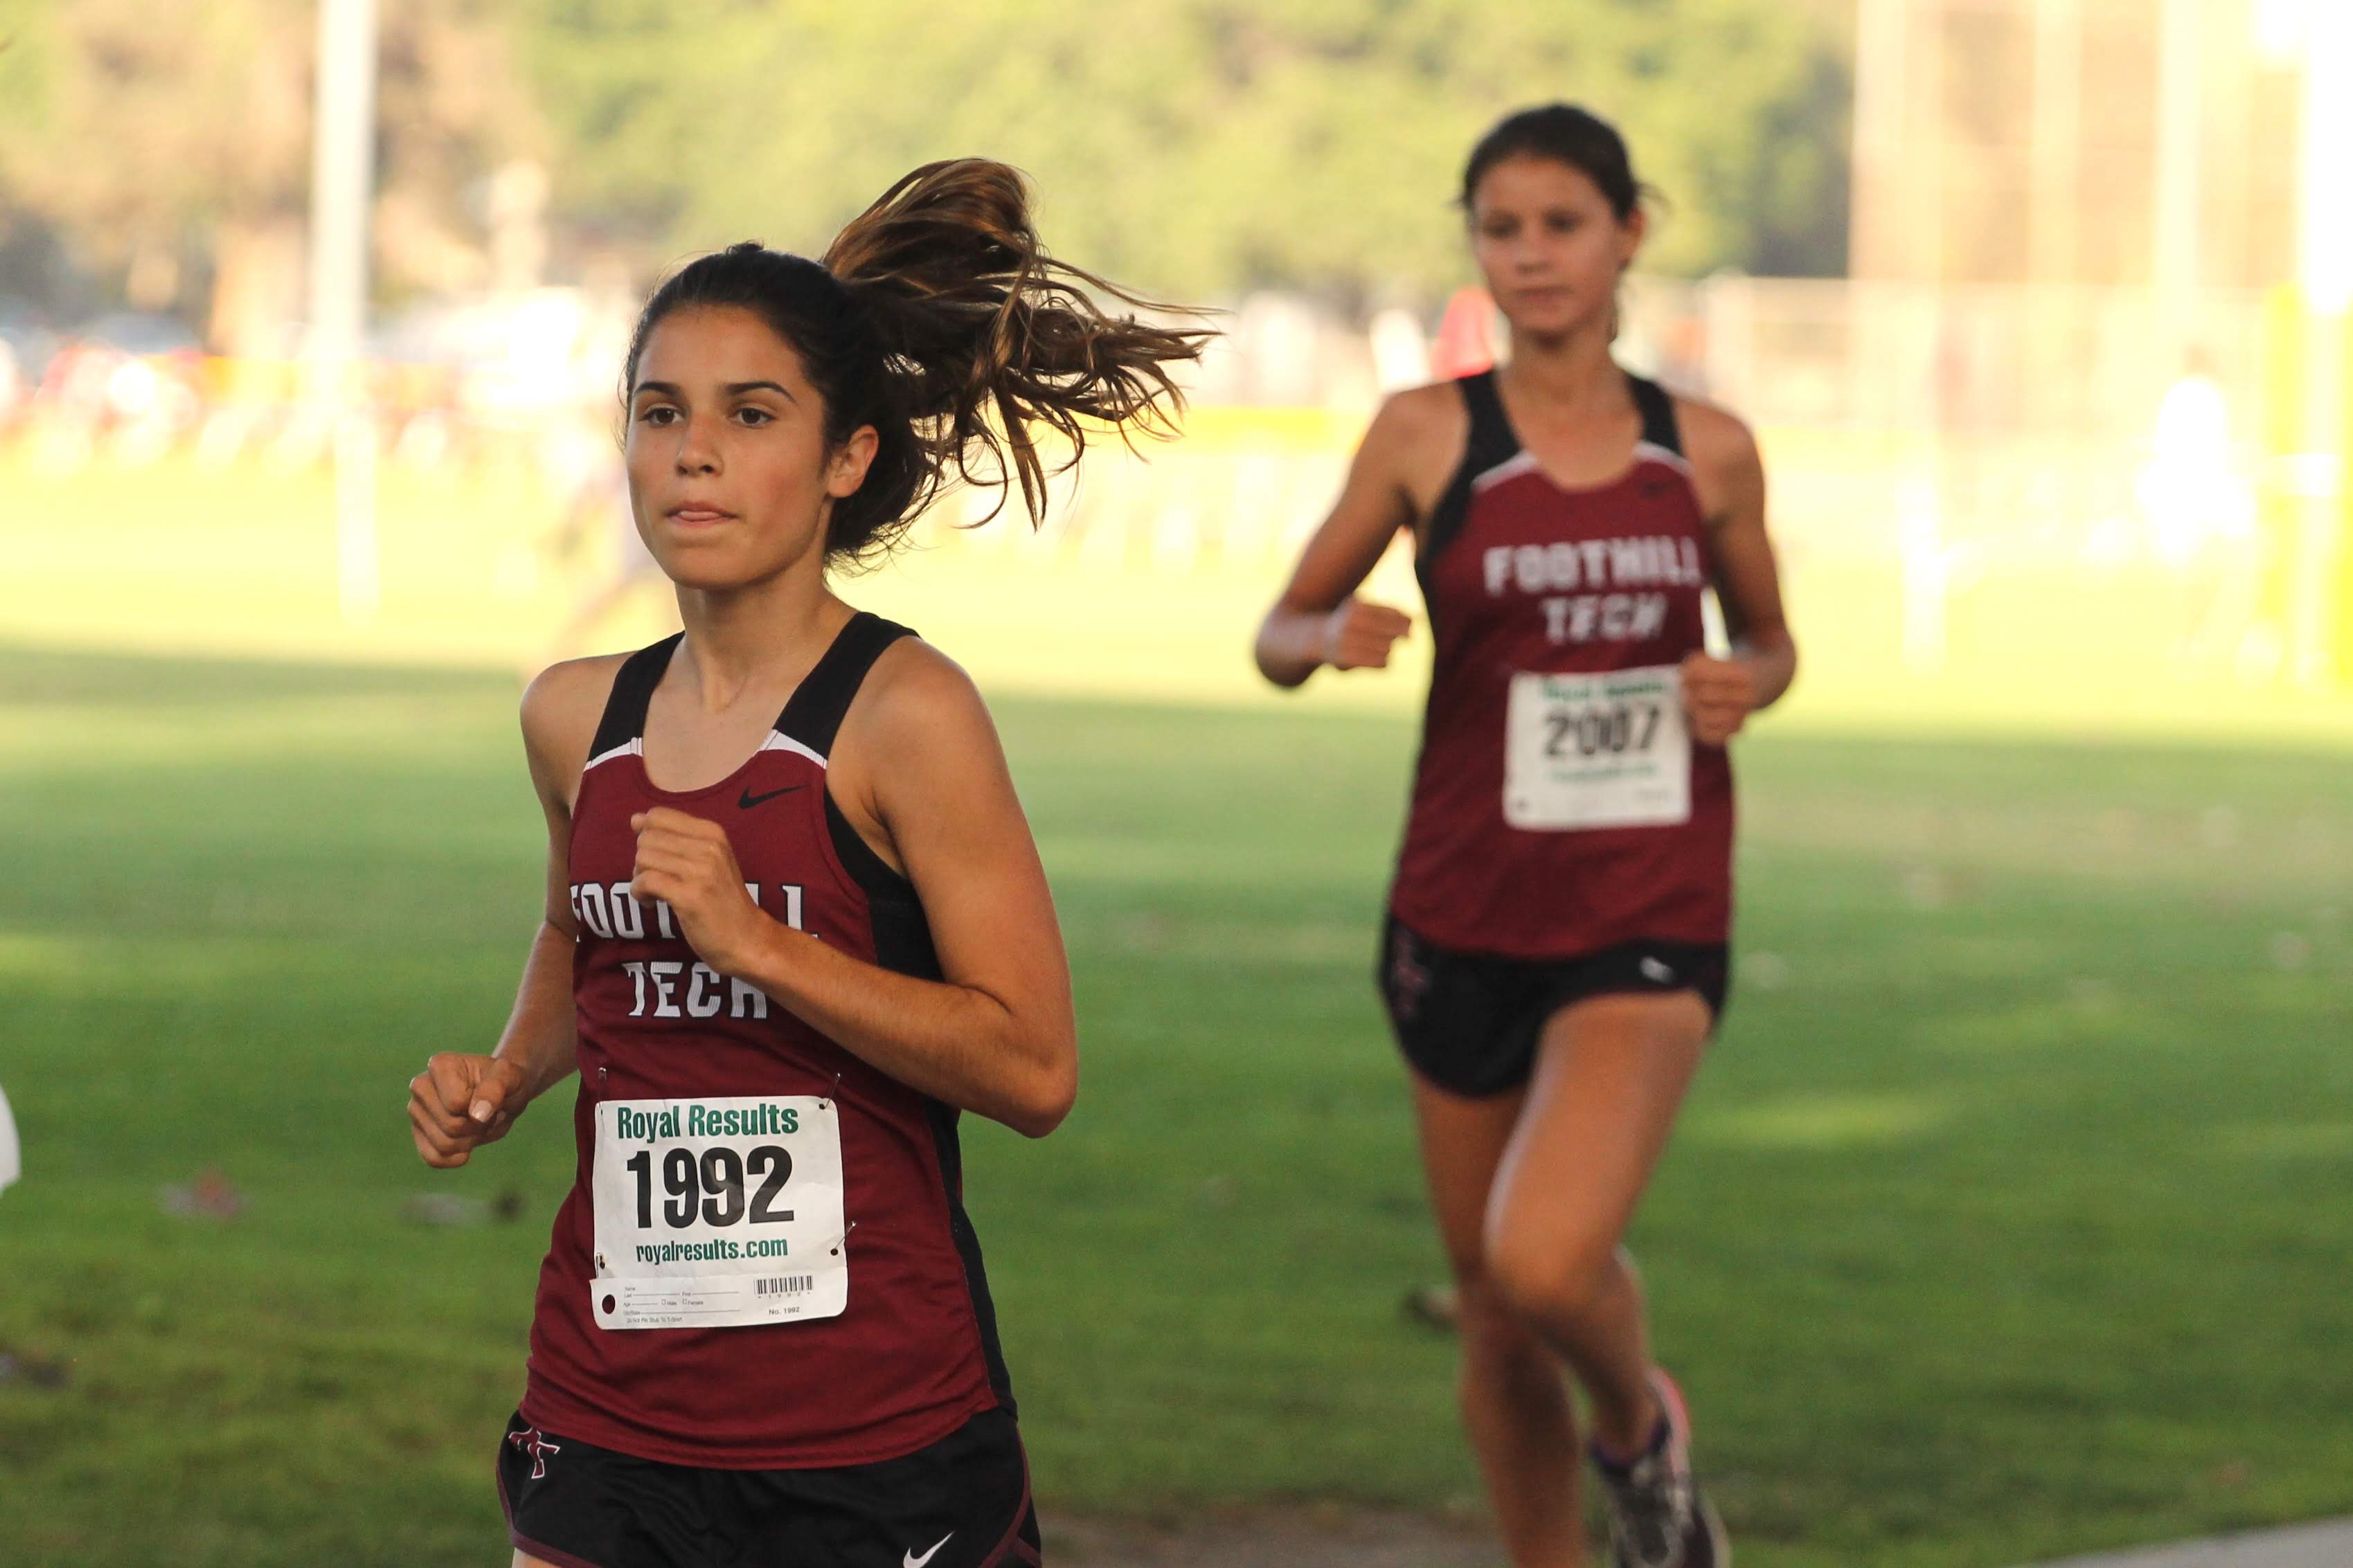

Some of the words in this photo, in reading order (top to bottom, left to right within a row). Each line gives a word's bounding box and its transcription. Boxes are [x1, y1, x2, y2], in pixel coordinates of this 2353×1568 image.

[1484, 537, 1701, 595] FOOTHILL
[1544, 703, 1659, 757] 2007
[622, 962, 767, 1018] TECH
[618, 1106, 680, 1143] Royal
[689, 1103, 798, 1137] Results
[627, 1146, 794, 1229] 1992
[636, 1238, 788, 1265] royalresults.com
